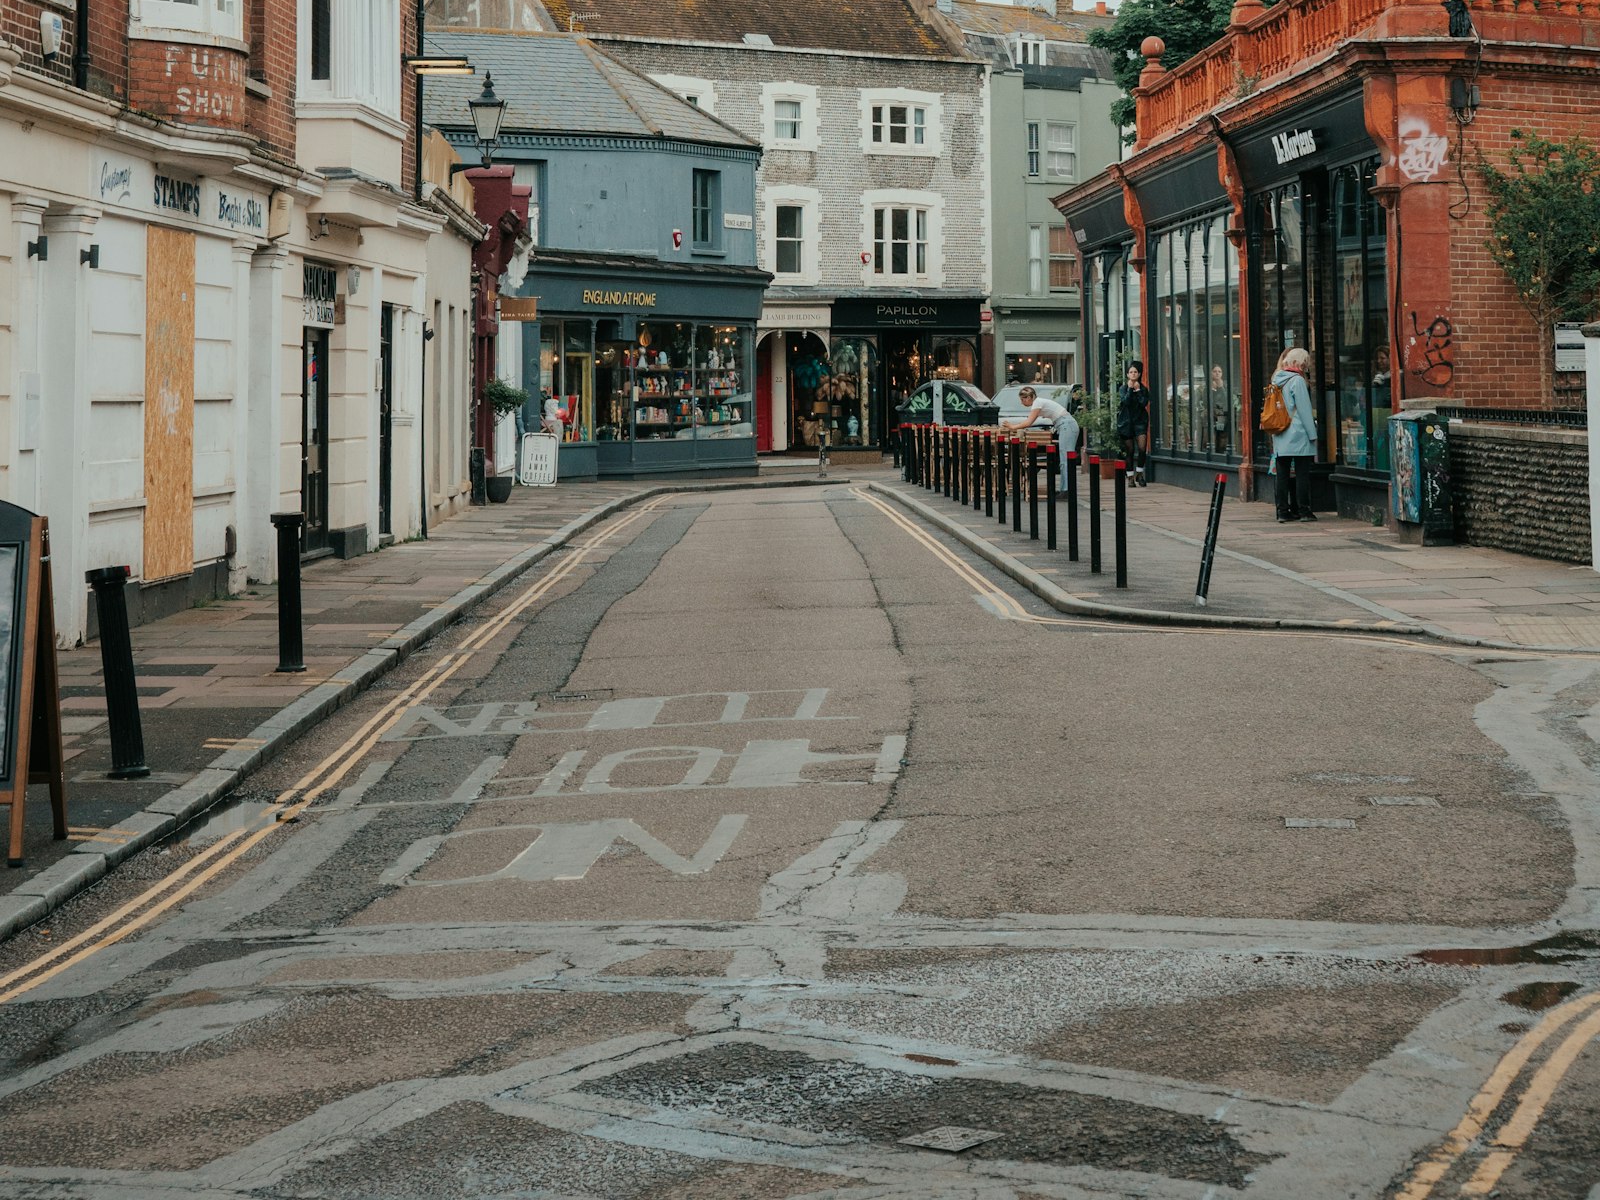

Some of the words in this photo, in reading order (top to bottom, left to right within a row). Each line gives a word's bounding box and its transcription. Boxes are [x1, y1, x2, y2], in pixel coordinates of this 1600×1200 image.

[153, 174, 201, 217] STAMPS
[303, 263, 337, 302] SHOGUN
[583, 289, 621, 305] ENGLAND
[622, 292, 633, 305] AT
[633, 292, 656, 306] HOME
[876, 304, 938, 316] PAPILLON
[766, 313, 786, 321] LAMB
[530, 453, 548, 462] TAKE
[529, 462, 548, 471] AWAY
[524, 471, 551, 482] COFFEE
